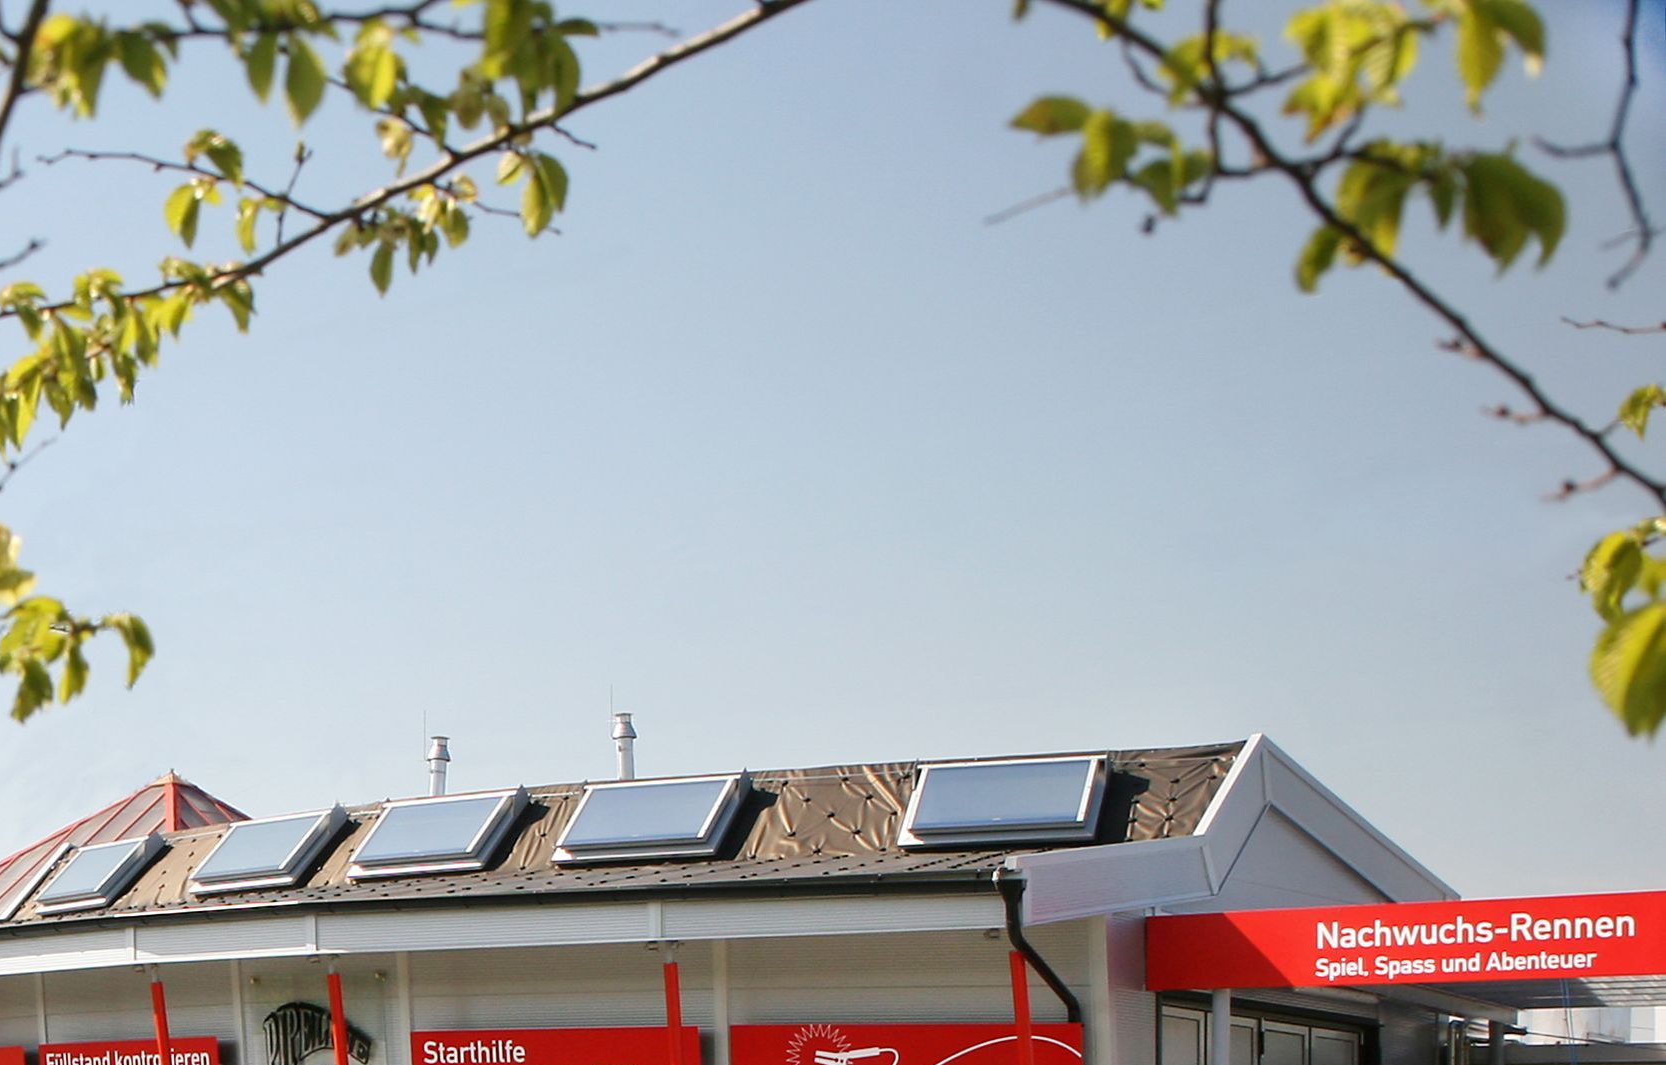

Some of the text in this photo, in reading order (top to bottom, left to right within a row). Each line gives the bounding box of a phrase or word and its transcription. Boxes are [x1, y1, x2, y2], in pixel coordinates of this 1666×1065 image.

[1316, 912, 1636, 950] Nachwuchs-Rennen
[1374, 955, 1435, 977] Spass
[1441, 953, 1481, 973] und
[1485, 951, 1597, 971] Abenteuer
[423, 1040, 526, 1064] Starthilfe
